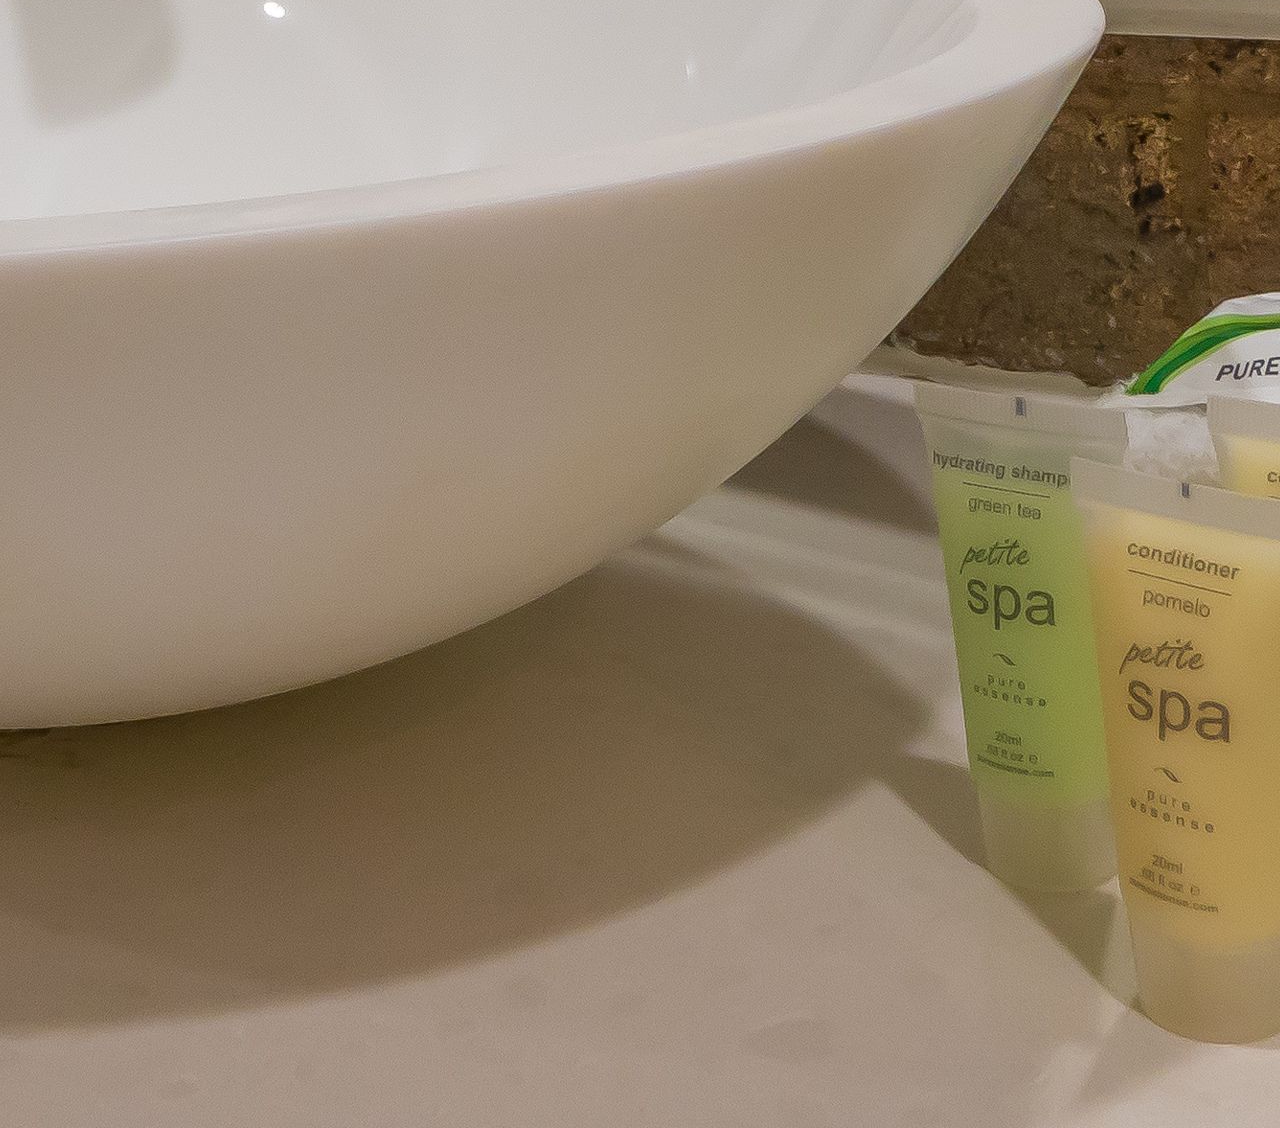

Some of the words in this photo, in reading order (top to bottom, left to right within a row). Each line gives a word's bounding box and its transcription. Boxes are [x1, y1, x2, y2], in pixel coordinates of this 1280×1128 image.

[932, 449, 1006, 480] hydrating
[1011, 464, 1072, 489] shamp
[967, 497, 1012, 515] green
[1017, 502, 1042, 520] tea
[959, 539, 1030, 574] petite
[1127, 542, 1241, 580] conditioner
[967, 578, 1057, 631] spa
[1142, 589, 1211, 618] pomelo
[1119, 638, 1205, 675] petite
[987, 674, 1026, 691] pure
[1127, 679, 1231, 744] spa
[1129, 797, 1215, 834] essense
[1146, 789, 1192, 812] pure
[1151, 854, 1184, 874] 20ml
